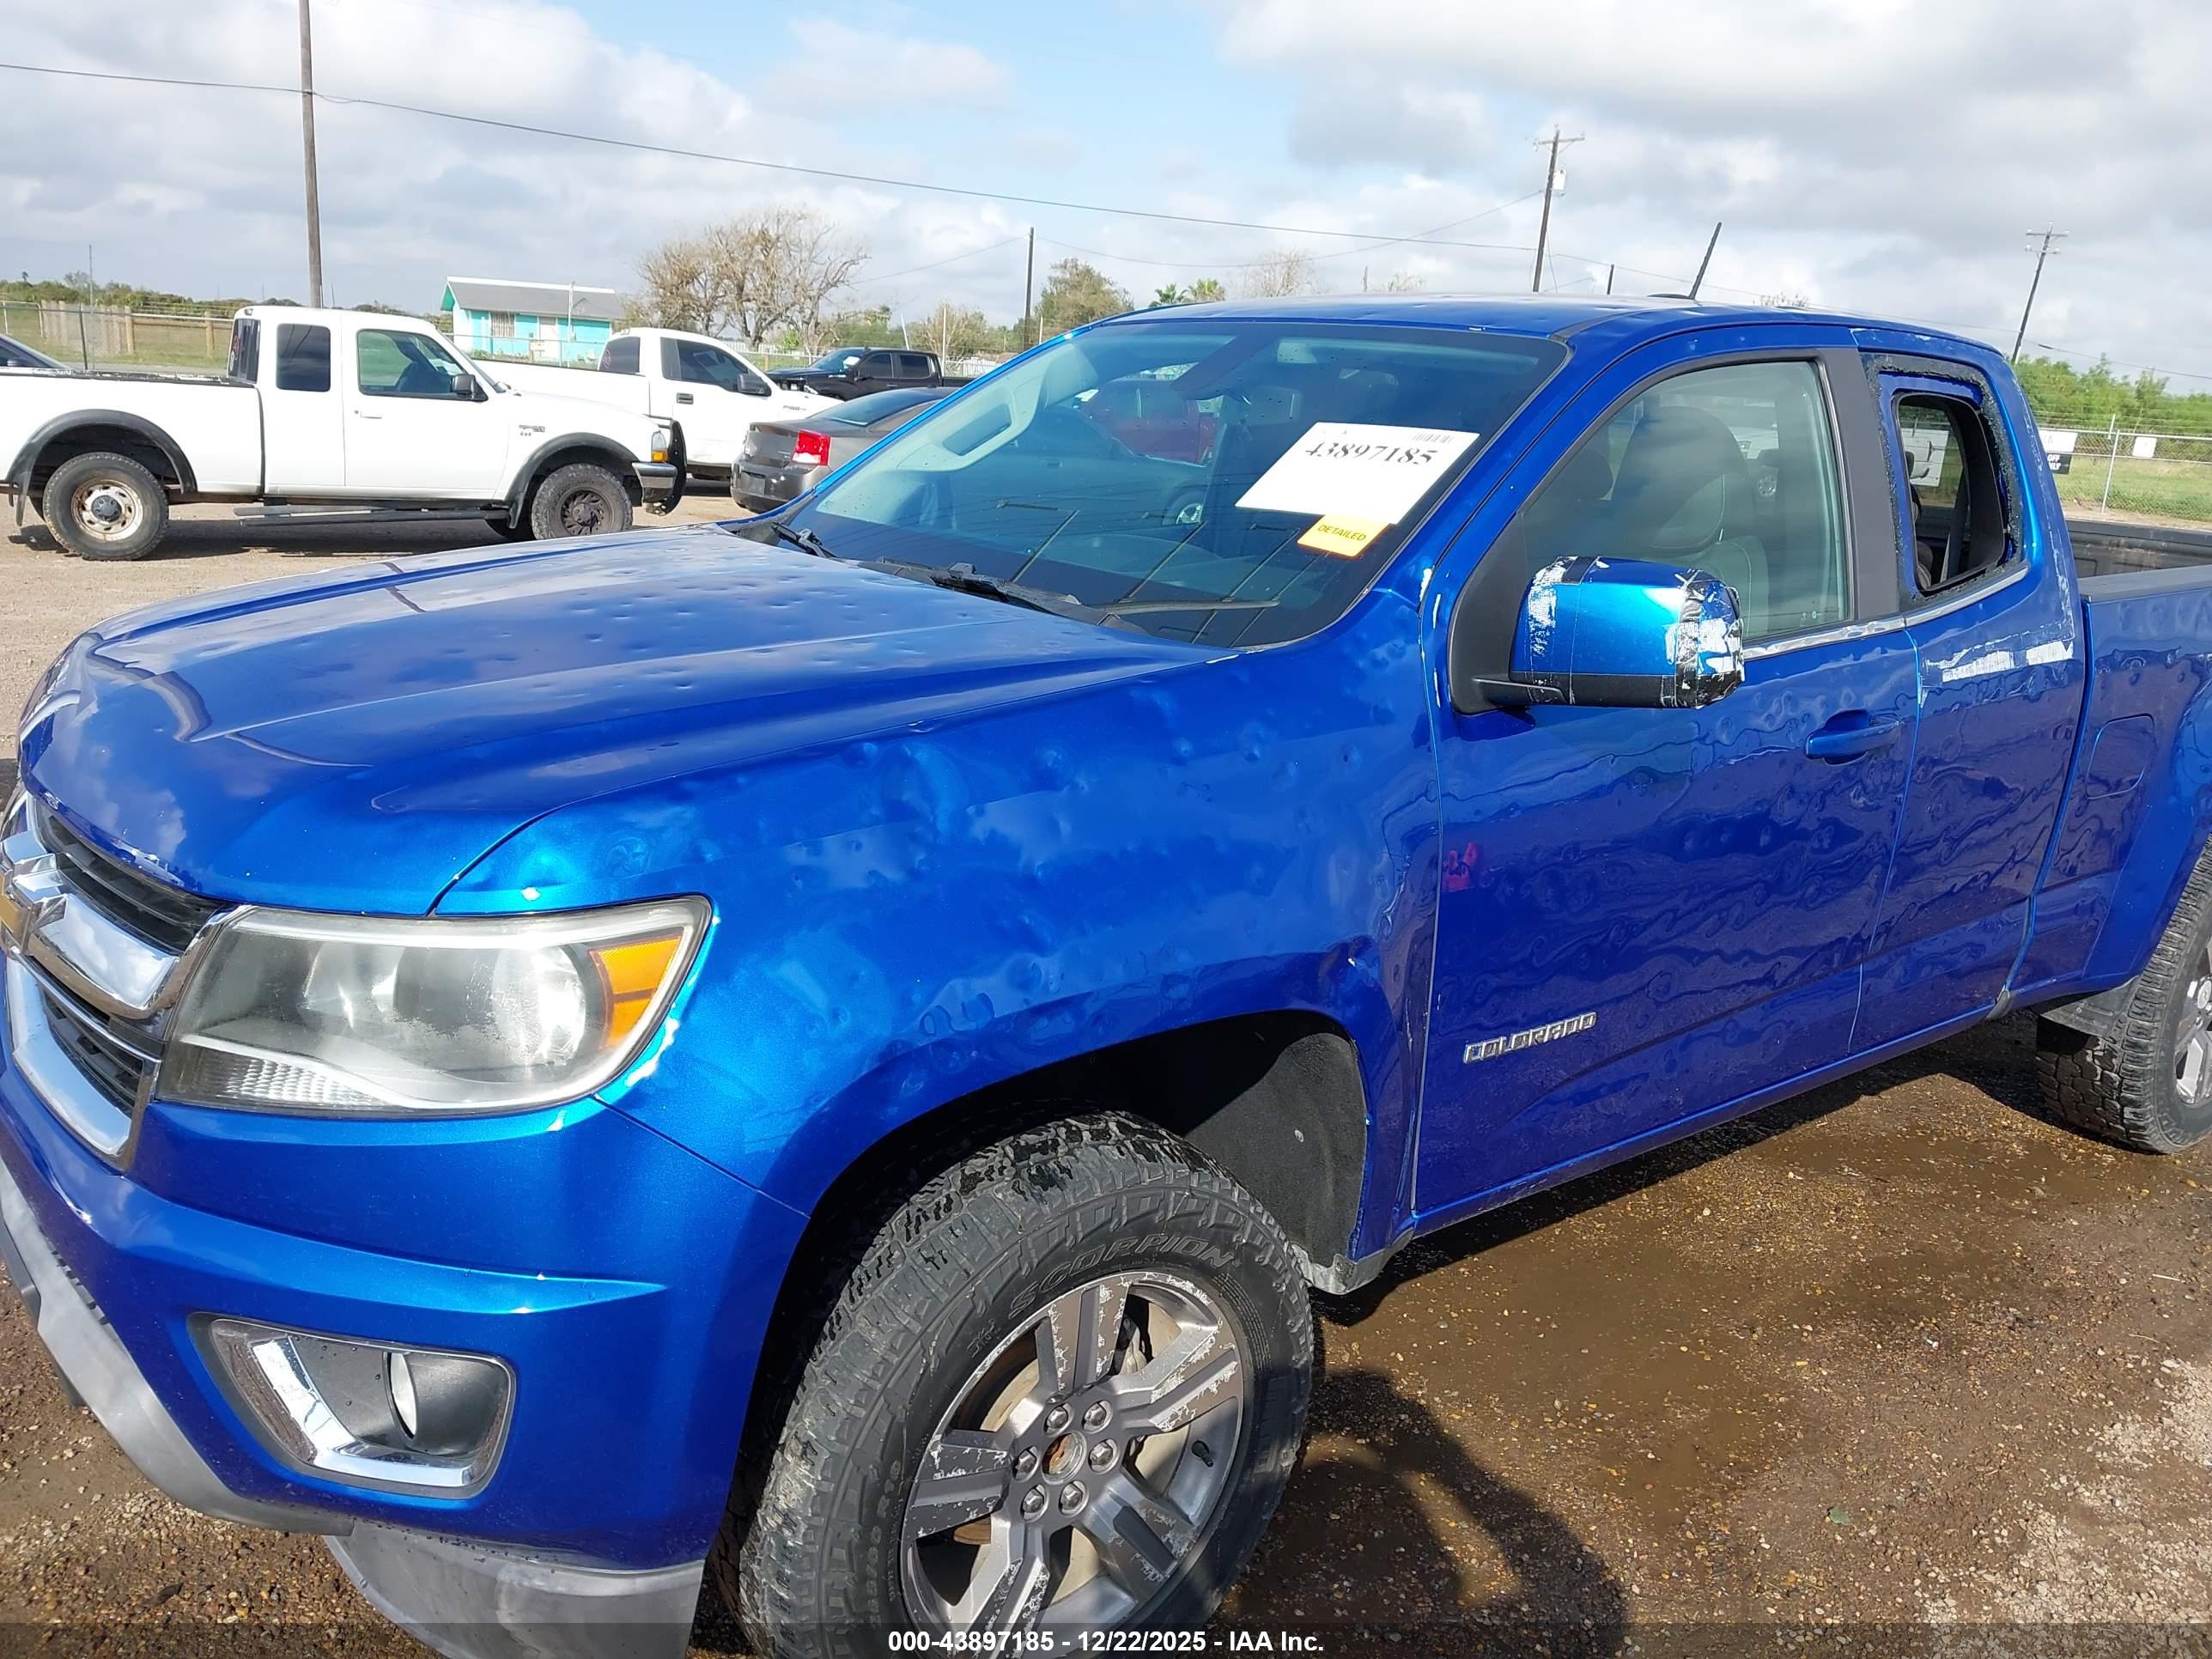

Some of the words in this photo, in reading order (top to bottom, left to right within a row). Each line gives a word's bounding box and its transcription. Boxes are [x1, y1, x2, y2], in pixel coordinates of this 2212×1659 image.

[1305, 441, 1438, 465] 43897185
[1317, 524, 1367, 541] DETAILED
[1462, 1011, 1597, 1064] COLORADO
[1008, 1233, 1234, 1320] SCORPION
